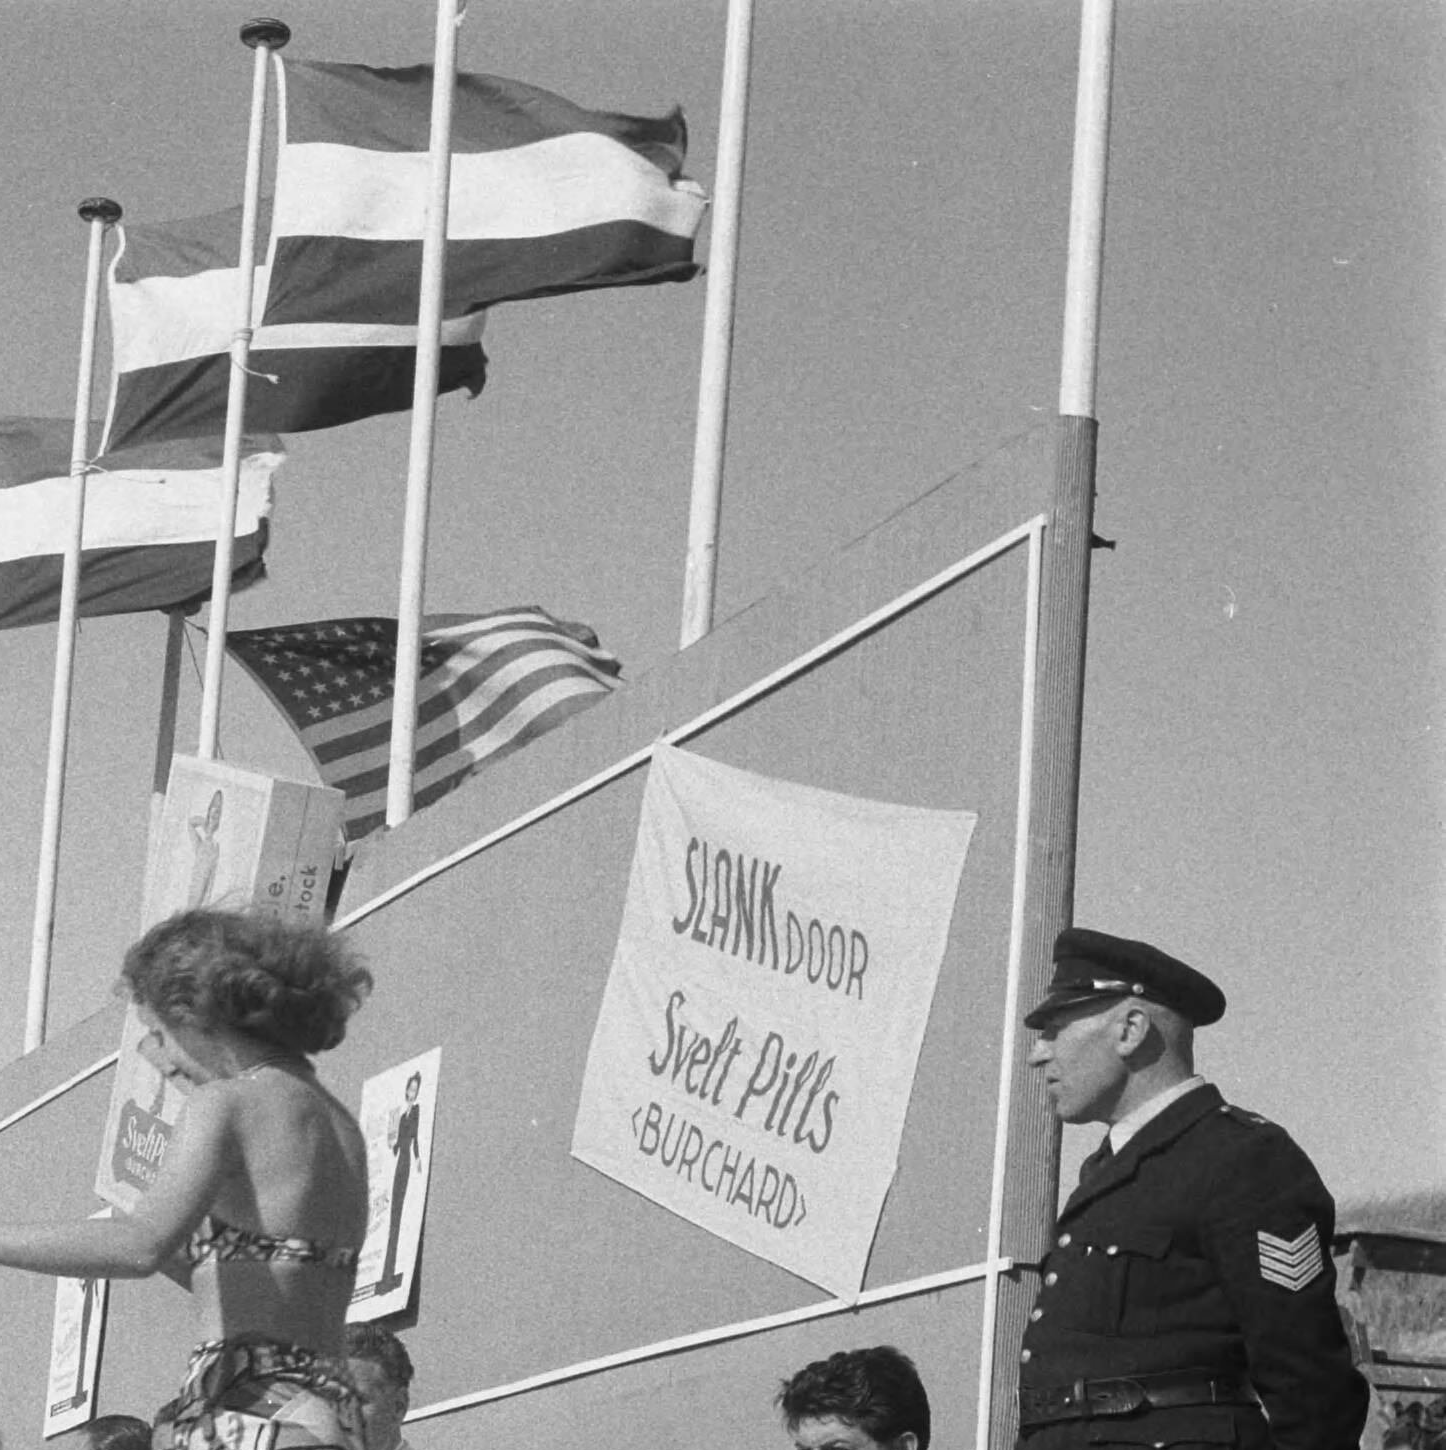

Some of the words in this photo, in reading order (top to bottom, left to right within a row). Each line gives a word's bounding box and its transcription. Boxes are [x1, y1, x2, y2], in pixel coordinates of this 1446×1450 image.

[672, 836, 782, 970] SLANK
[784, 910, 869, 1000] DOOR
[648, 990, 741, 1104] Svelt
[735, 1031, 839, 1154] Pills
